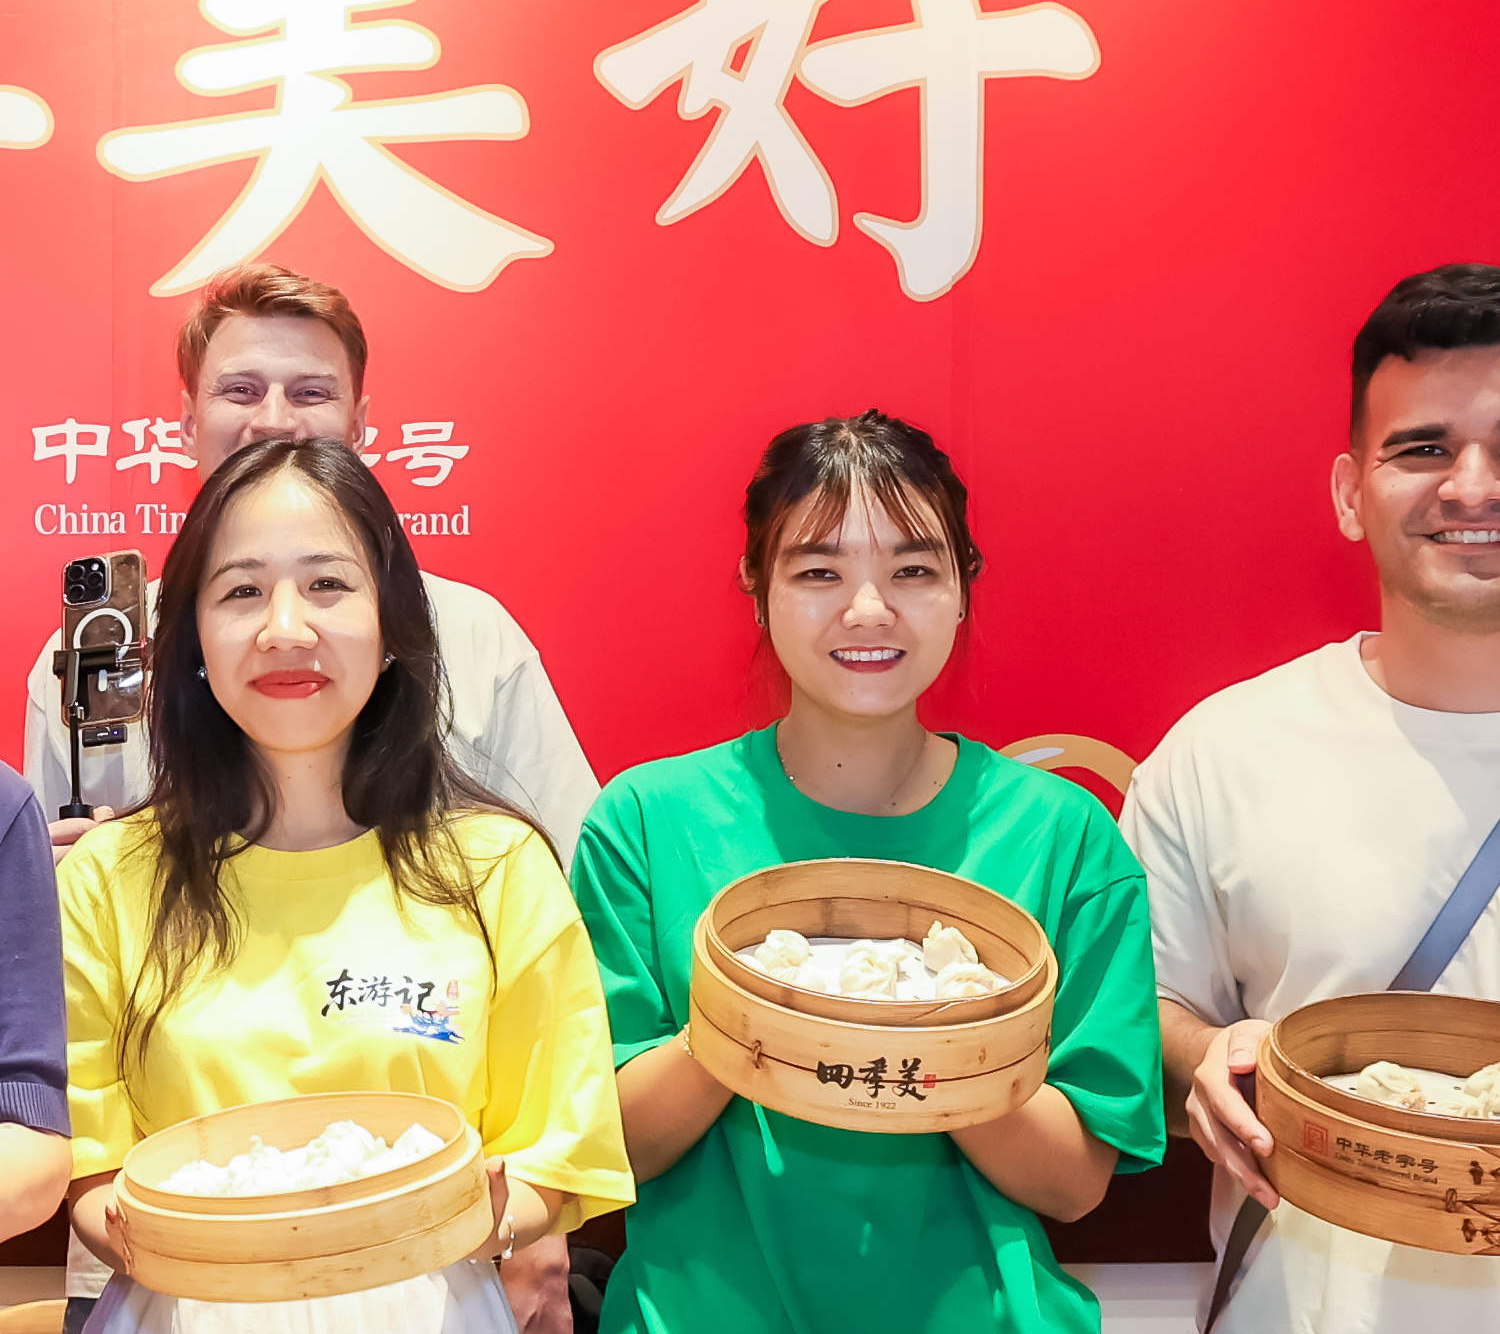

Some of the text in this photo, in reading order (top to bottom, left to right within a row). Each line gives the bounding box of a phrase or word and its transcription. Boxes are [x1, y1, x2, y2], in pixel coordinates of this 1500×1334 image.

[34, 503, 126, 535] China
[397, 504, 471, 536] rand
[320, 968, 436, 1018] 东游记
[816, 1056, 928, 1102] 四季美
